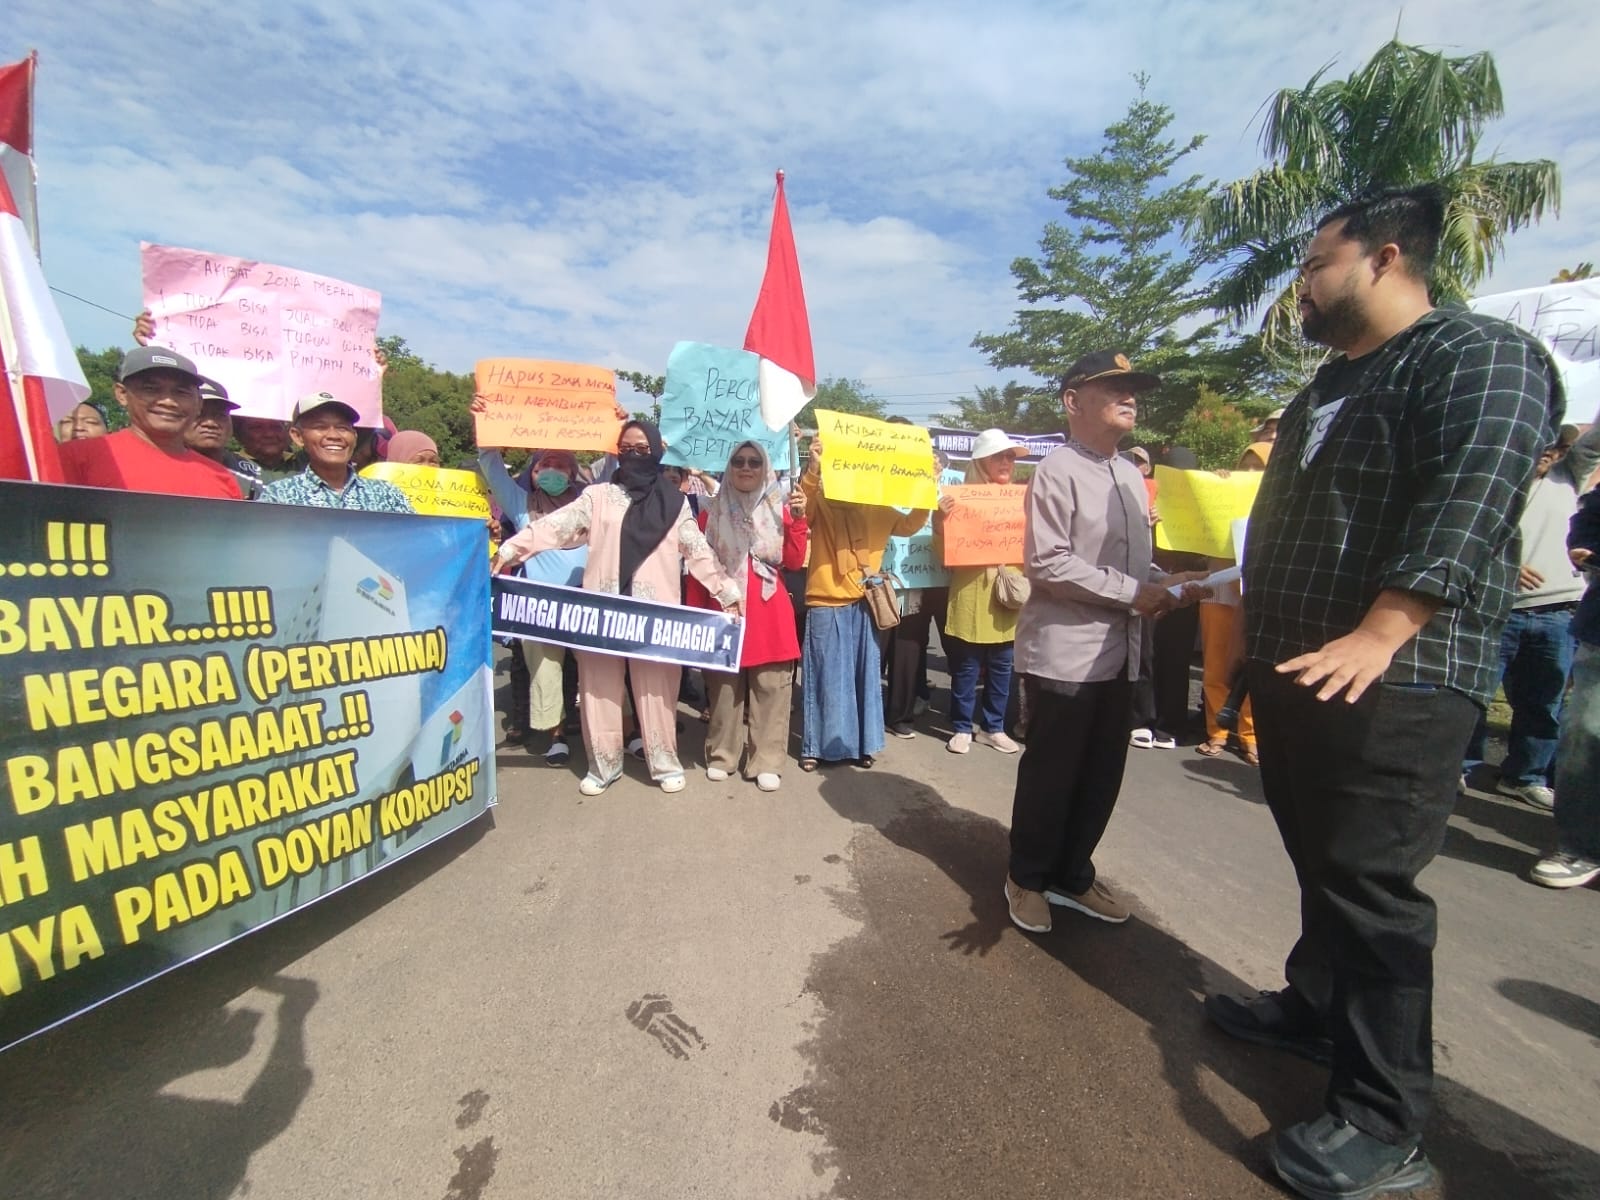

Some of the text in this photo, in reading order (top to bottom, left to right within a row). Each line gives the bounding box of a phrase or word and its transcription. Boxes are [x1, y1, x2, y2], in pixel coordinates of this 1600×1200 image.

[204, 259, 251, 280] AKIBAT
[263, 271, 301, 290] ZONA
[239, 298, 268, 314] BISA
[240, 322, 268, 337] BISA
[189, 342, 229, 357] TIDAK
[243, 347, 274, 362] BISA
[487, 365, 544, 388] HAPUS
[704, 367, 760, 402] PERCU
[524, 396, 596, 411] MEMBUAT
[483, 410, 523, 422] KAMI
[684, 406, 752, 433] BAYAR
[510, 424, 602, 441] KAMI RESAH
[938, 434, 969, 452] WARGA
[500, 592, 559, 630] WARGA
[559, 602, 600, 636] KOTA
[602, 610, 649, 643] TIDAK
[651, 618, 716, 653] BAHAGIA
[24, 629, 447, 731] NEGARA (PERTAMINA)
[0, 752, 358, 908] H MASYARAKAT
[114, 850, 252, 946] PADA
[257, 804, 373, 888] DOYAN
